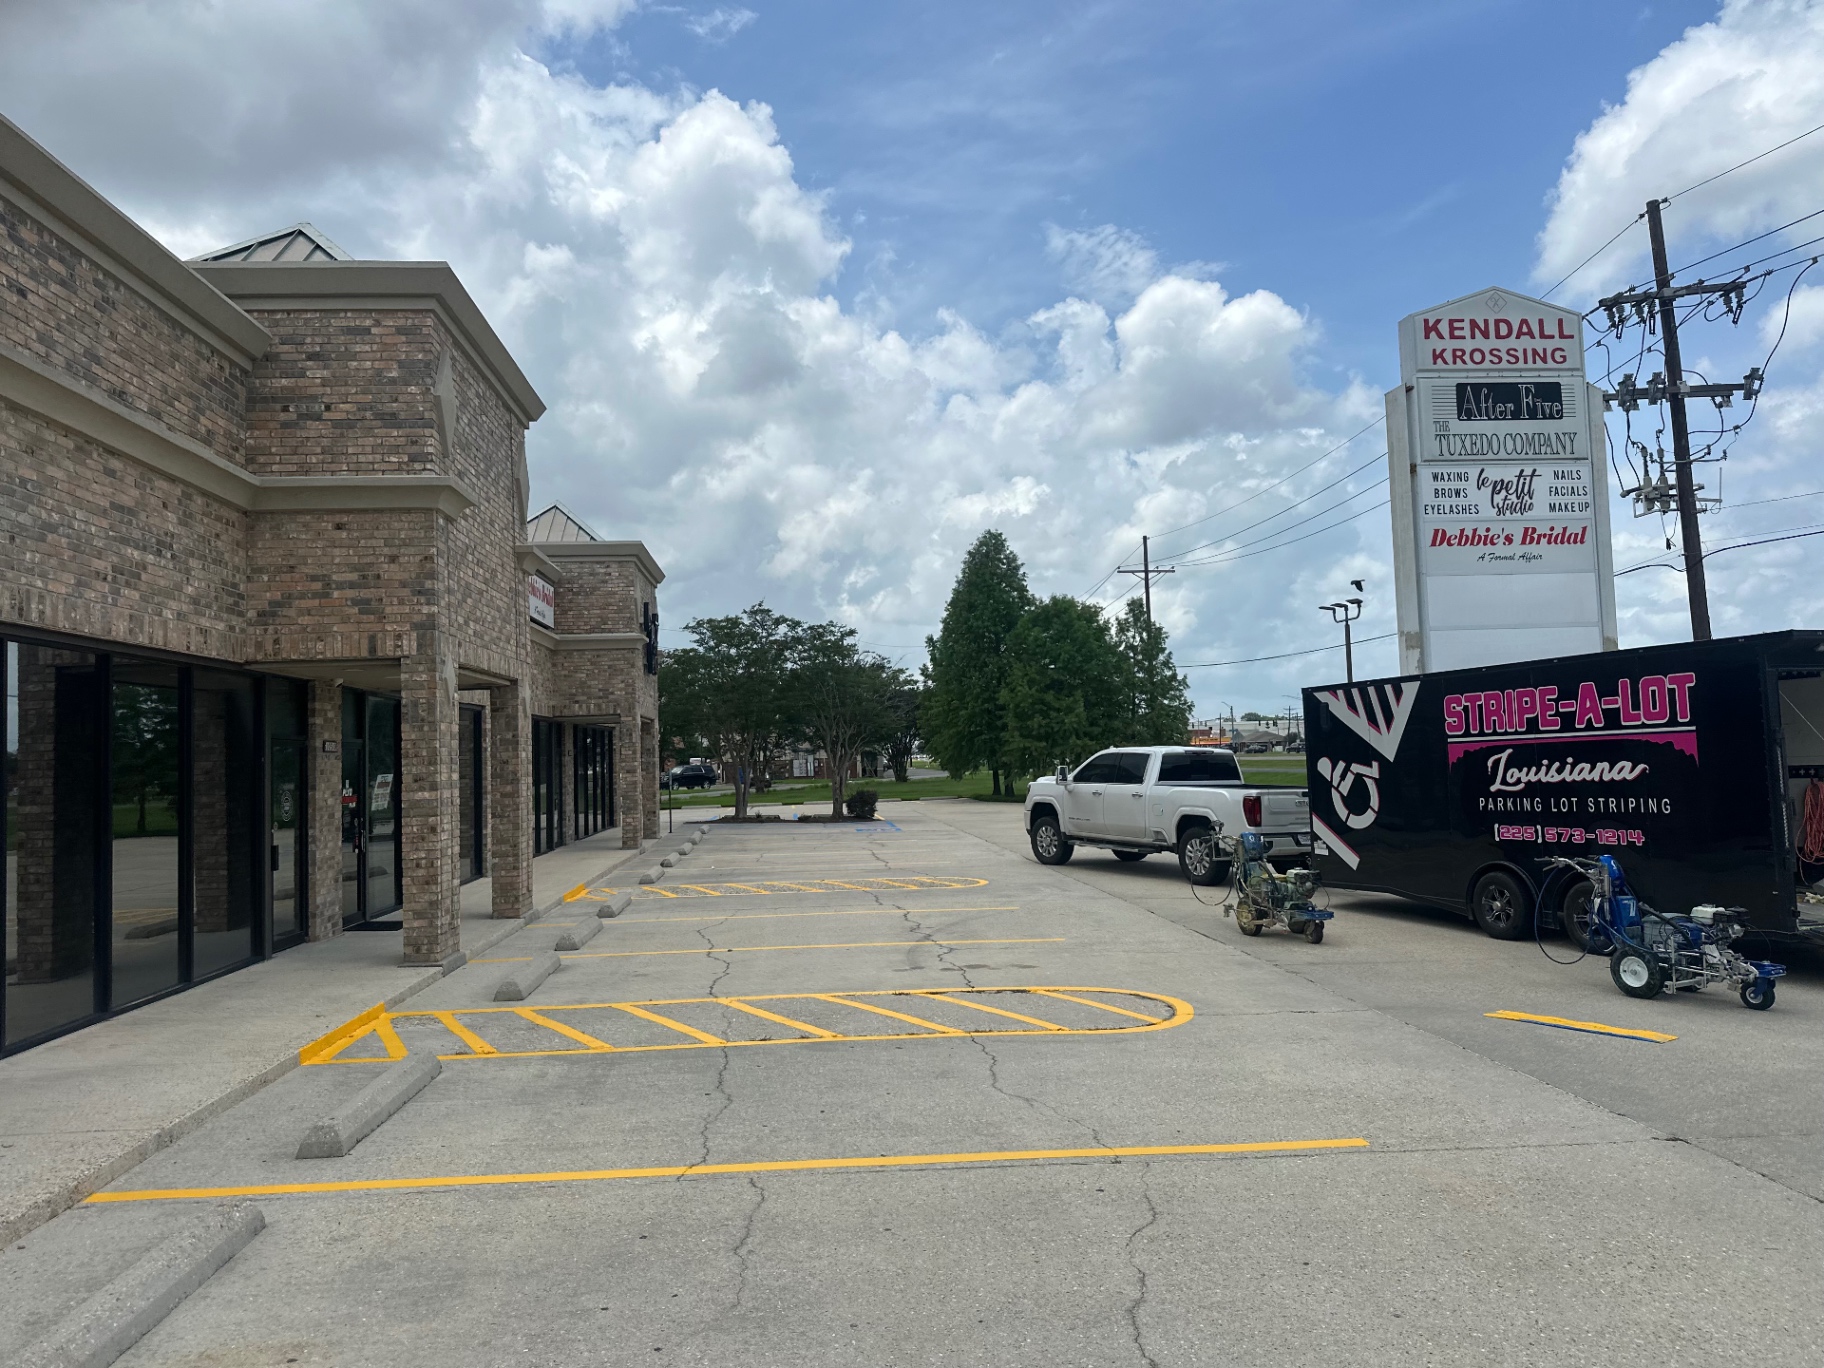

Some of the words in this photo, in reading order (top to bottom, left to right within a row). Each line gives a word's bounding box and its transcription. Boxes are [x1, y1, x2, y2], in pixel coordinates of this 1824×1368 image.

[1423, 318, 1575, 340] KENDALL
[1432, 347, 1567, 365] KROSSING
[1460, 385, 1515, 420] After
[1518, 384, 1562, 419] Five
[1433, 420, 1450, 433] THE
[1434, 433, 1501, 457] TUXEDO
[1503, 432, 1577, 456] COMPANY
[1431, 471, 1469, 483] WAXING
[1476, 467, 1494, 491] le
[1553, 469, 1582, 481] NAILS
[1434, 488, 1468, 499] BROWS
[1491, 468, 1542, 509] petit
[1549, 485, 1588, 497] FACIALS
[1424, 504, 1480, 515] EYELASHES
[1495, 495, 1534, 516] studio
[1549, 502, 1577, 513] MAKE
[1578, 501, 1590, 513] UP
[1430, 527, 1514, 547] Debbie's
[1520, 525, 1588, 546] Bridal
[1444, 672, 1696, 734] STRIPE-A-LOT
[1487, 748, 1649, 792] Louisiana
[1479, 797, 1542, 812] PARKING
[1551, 797, 1577, 812] LOT
[1587, 798, 1671, 814] STRIPING
[1544, 828, 1645, 846] 573-1214
